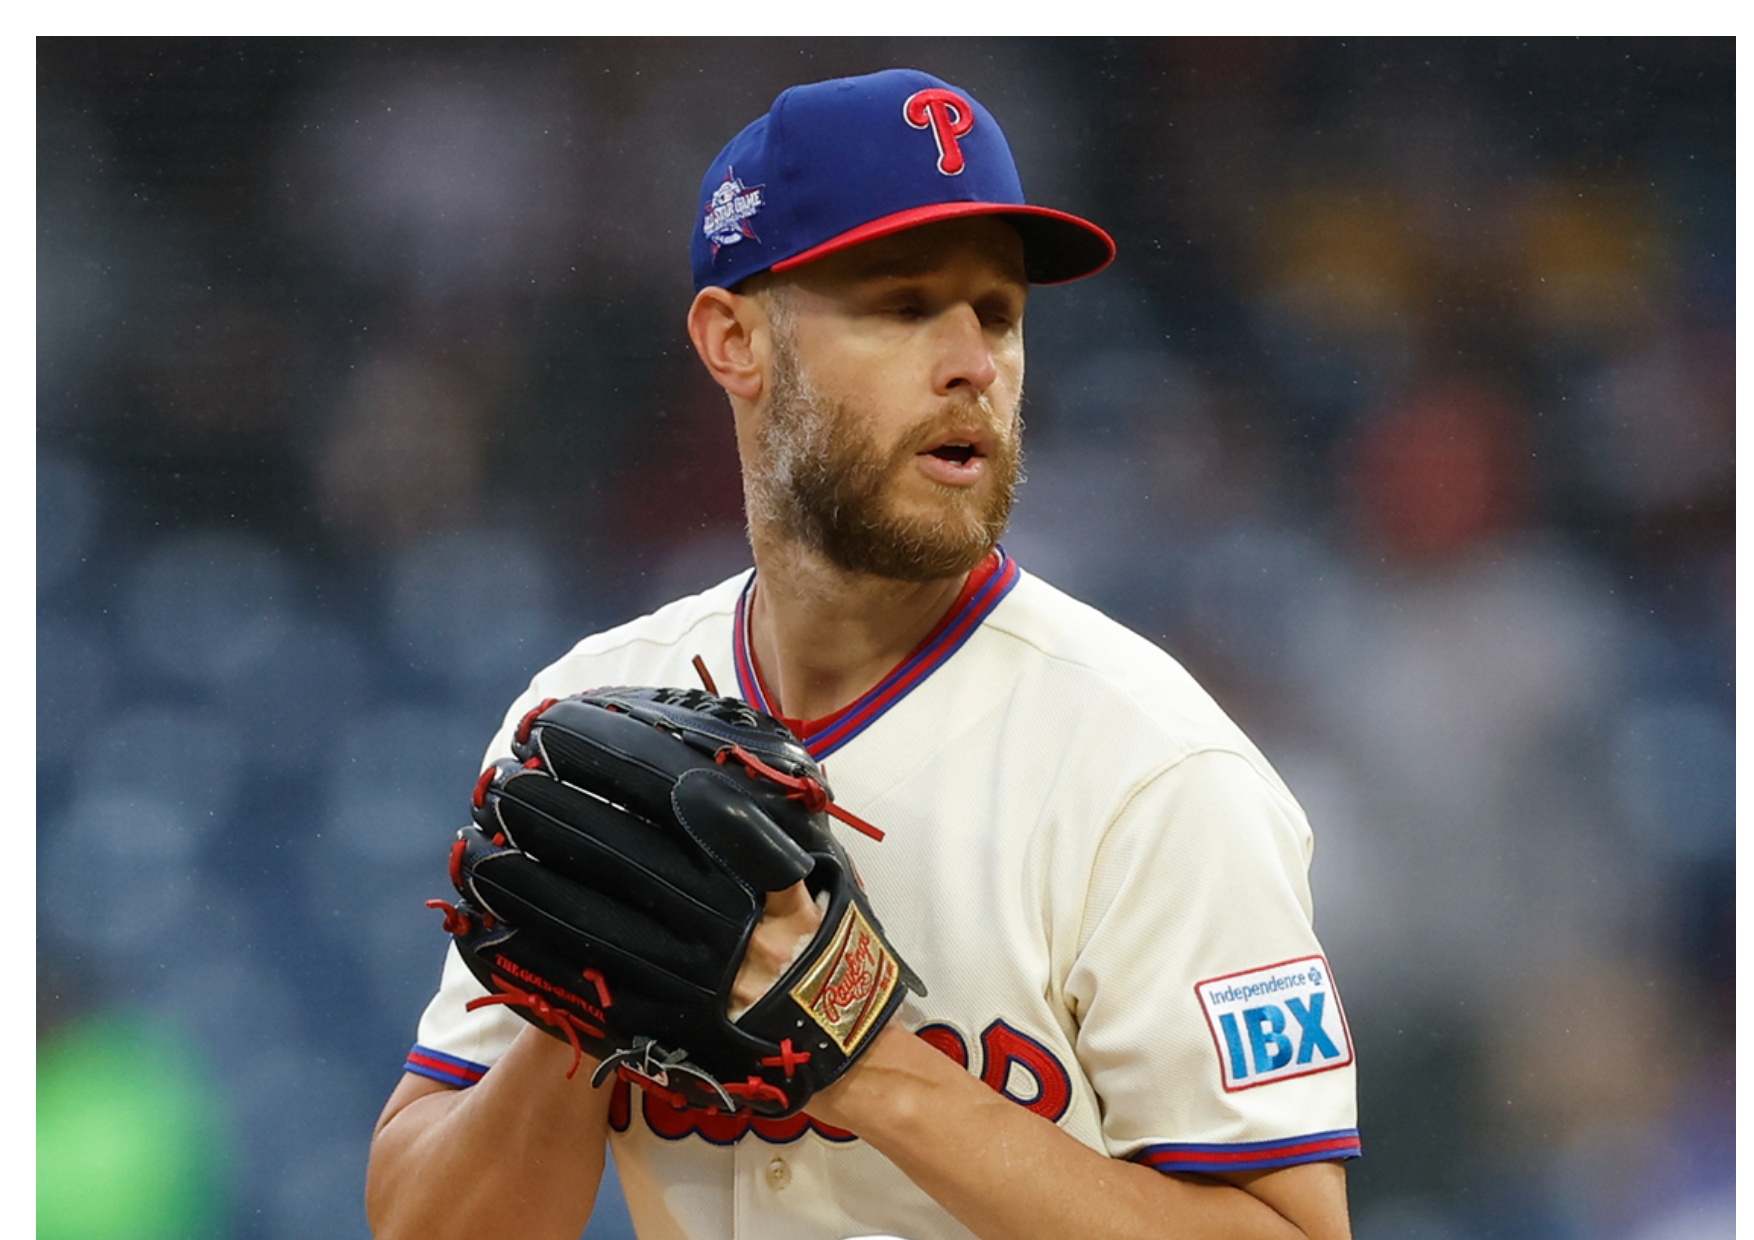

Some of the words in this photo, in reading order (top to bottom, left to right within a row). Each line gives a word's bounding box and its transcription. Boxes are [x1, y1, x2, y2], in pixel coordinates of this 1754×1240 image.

[903, 88, 975, 177] P
[822, 931, 876, 1014] Rawlings
[1209, 970, 1307, 1005] Independence
[1218, 992, 1341, 1081] IBX
